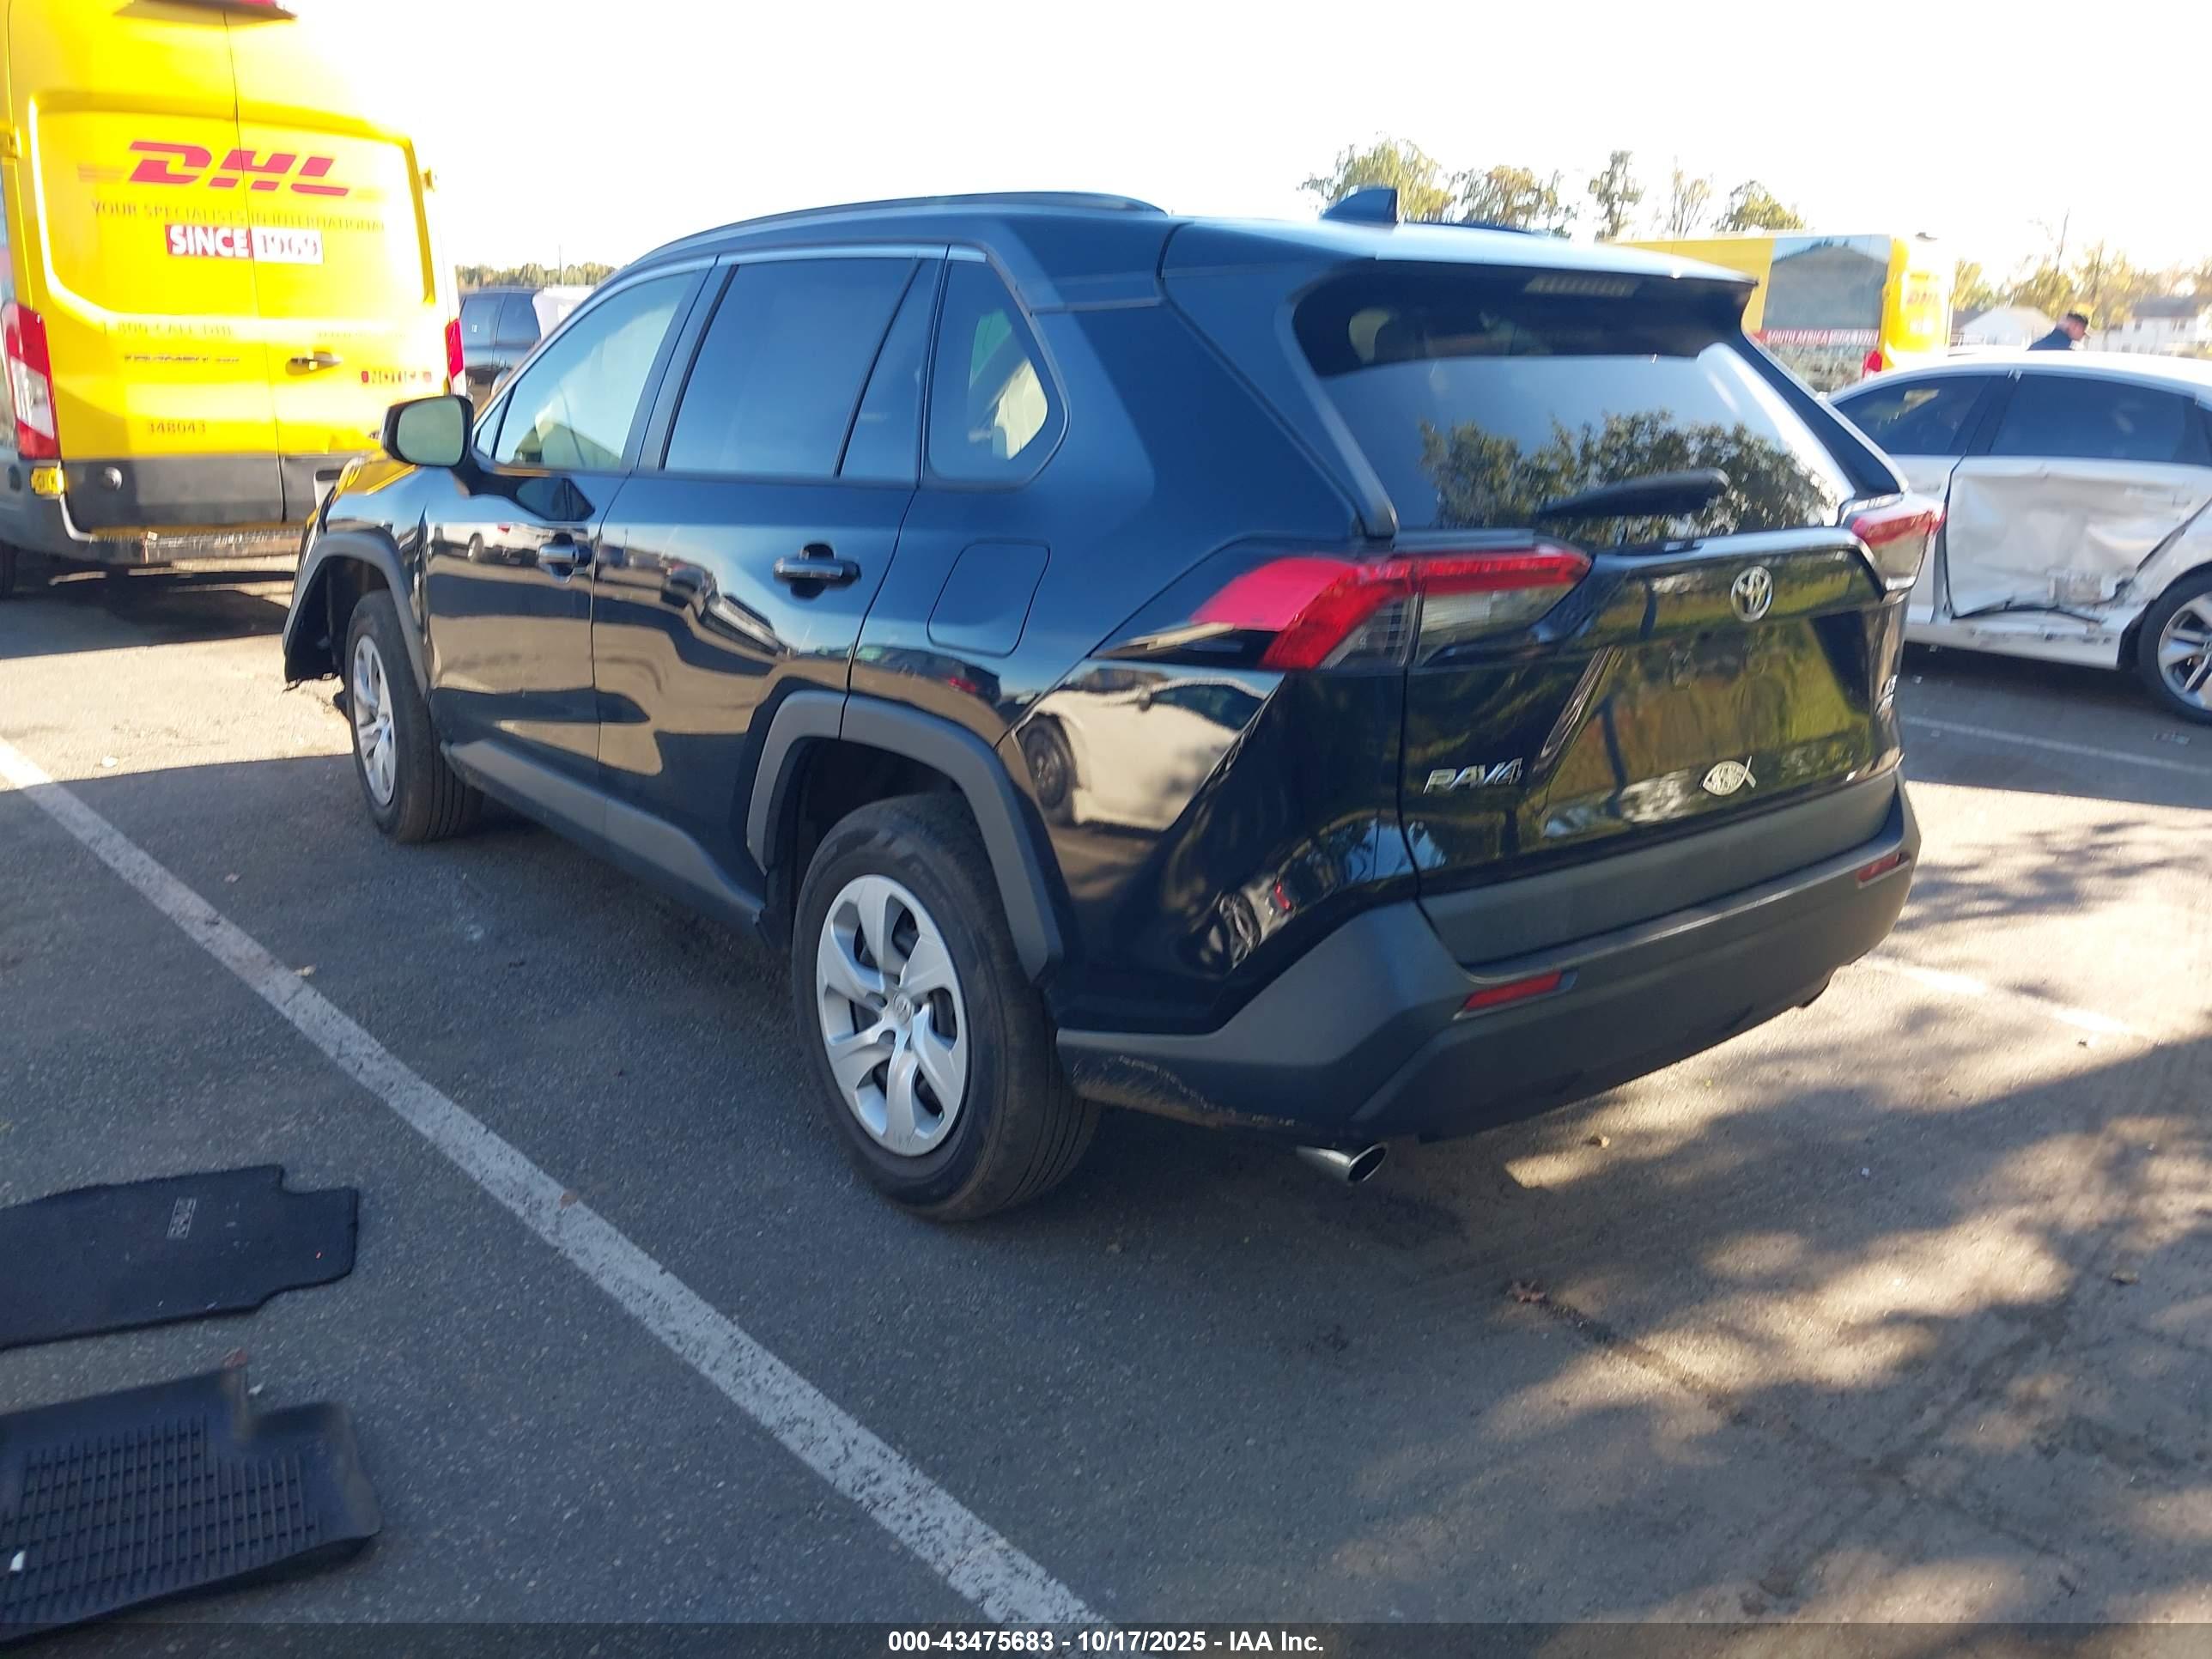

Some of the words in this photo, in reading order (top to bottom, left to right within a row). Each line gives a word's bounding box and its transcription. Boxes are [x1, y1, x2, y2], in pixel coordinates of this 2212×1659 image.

[128, 140, 350, 197] DHL
[91, 198, 137, 216] YOUR
[143, 203, 246, 222] SPECIALISTS
[168, 224, 250, 258] SINCE
[1422, 757, 1523, 795] RAV4
